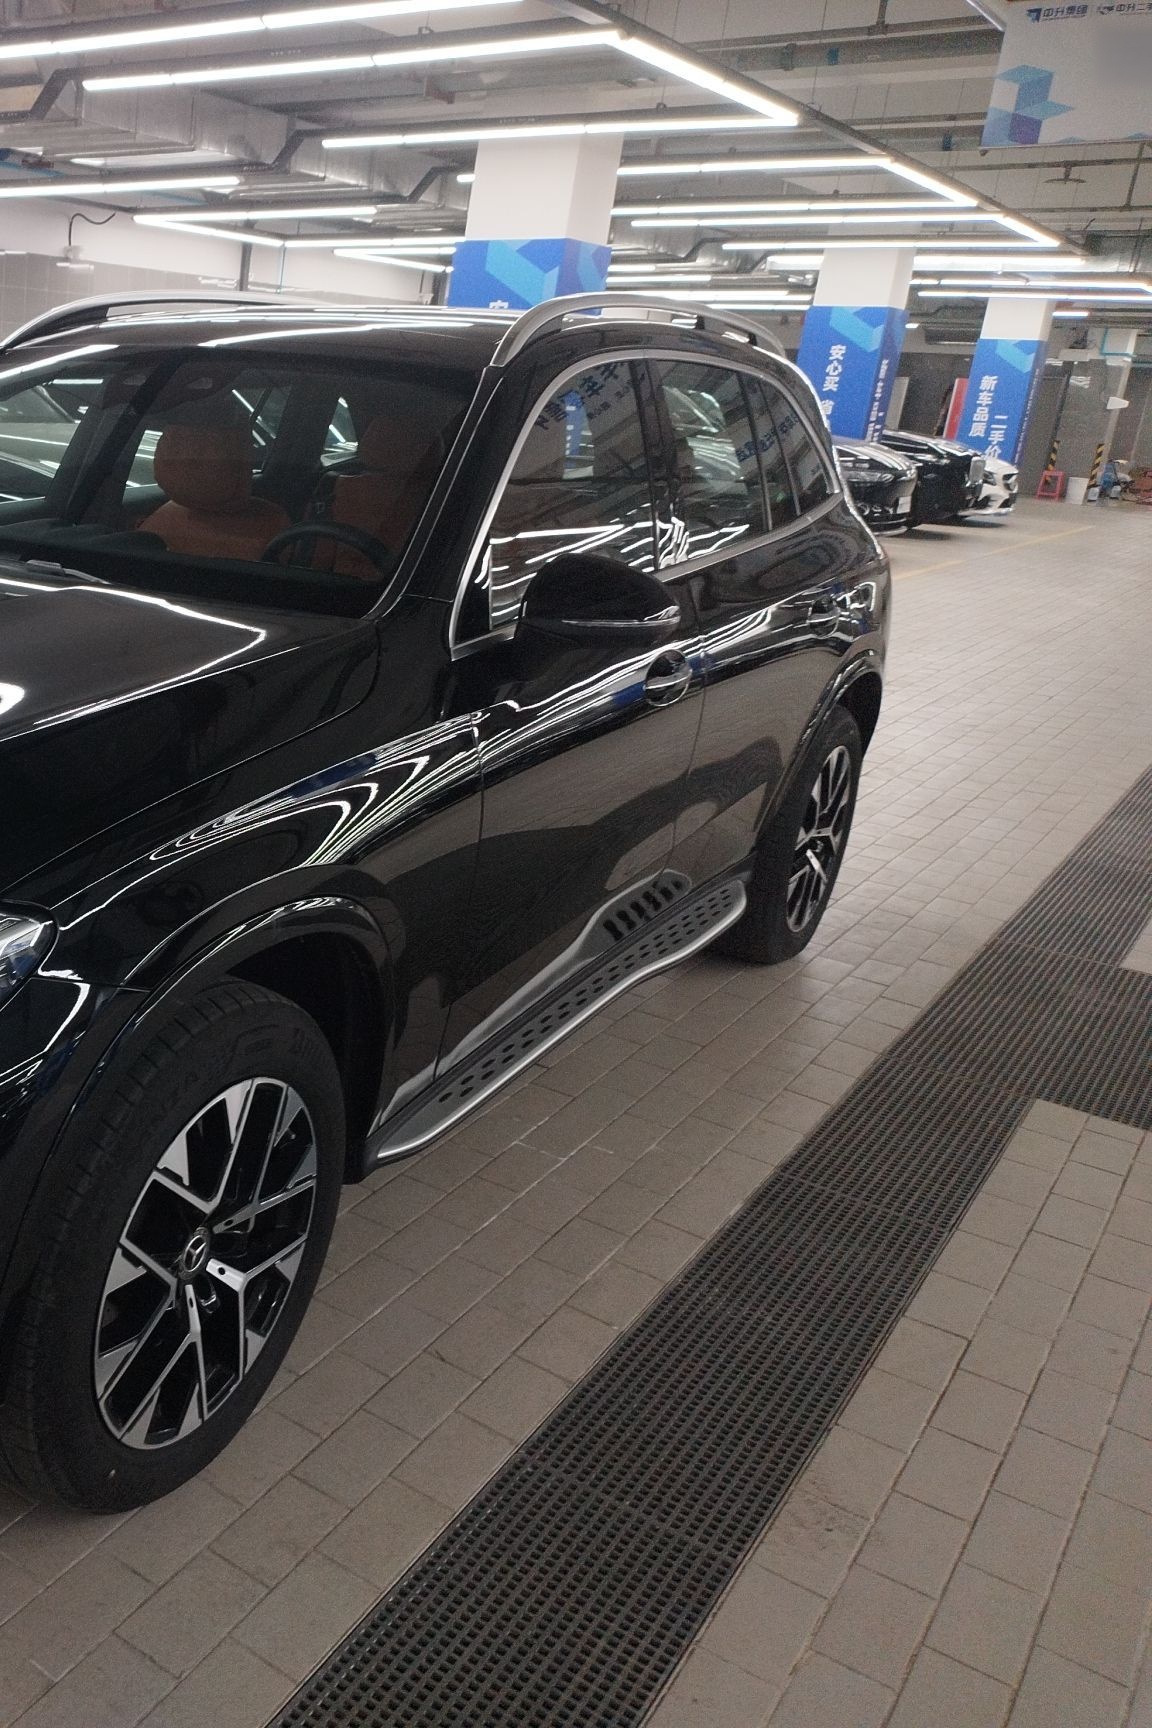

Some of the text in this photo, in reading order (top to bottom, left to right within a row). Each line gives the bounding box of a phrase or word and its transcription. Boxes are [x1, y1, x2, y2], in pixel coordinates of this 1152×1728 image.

[822, 344, 847, 392] 安心买
[968, 375, 999, 438] 新车品质
[984, 415, 1009, 460] 二手价
